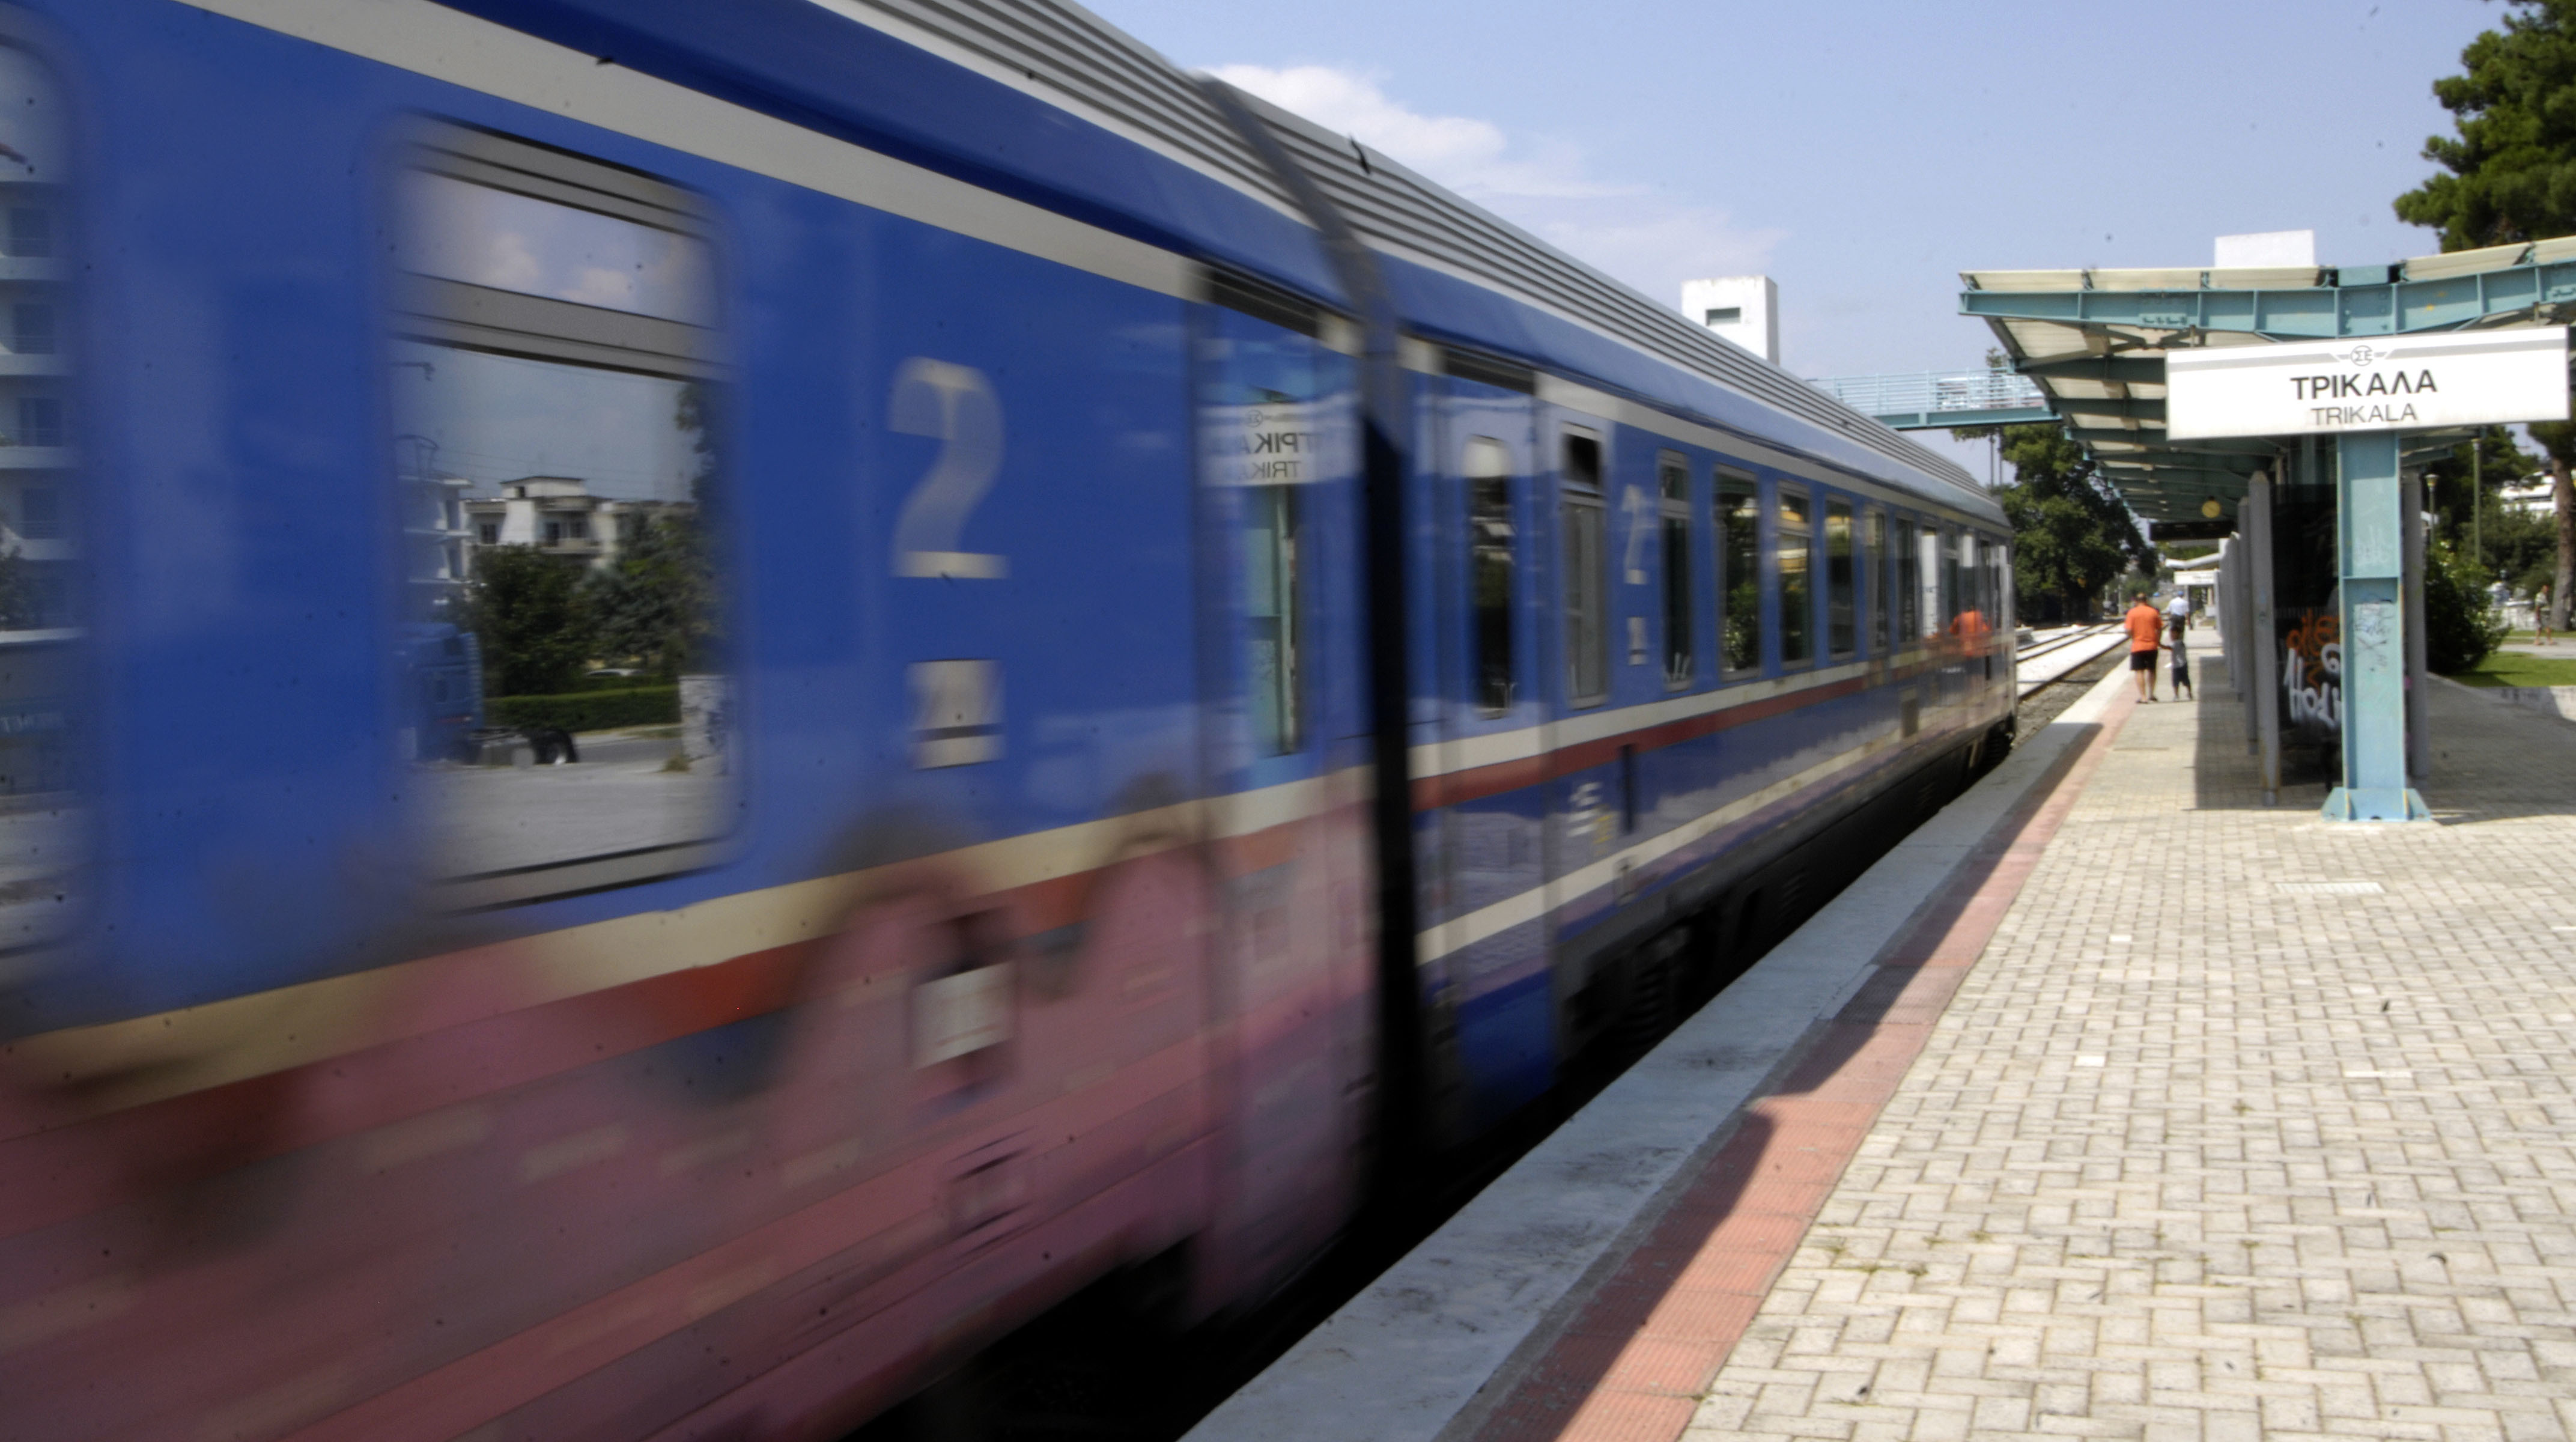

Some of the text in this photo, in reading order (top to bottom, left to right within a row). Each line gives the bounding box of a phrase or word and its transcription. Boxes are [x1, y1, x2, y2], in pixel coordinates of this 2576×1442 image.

[2290, 369, 2438, 400] ΤΡΙΚΑΛΑ
[2310, 403, 2417, 425] TRIKALA
[888, 356, 1012, 580] 2
